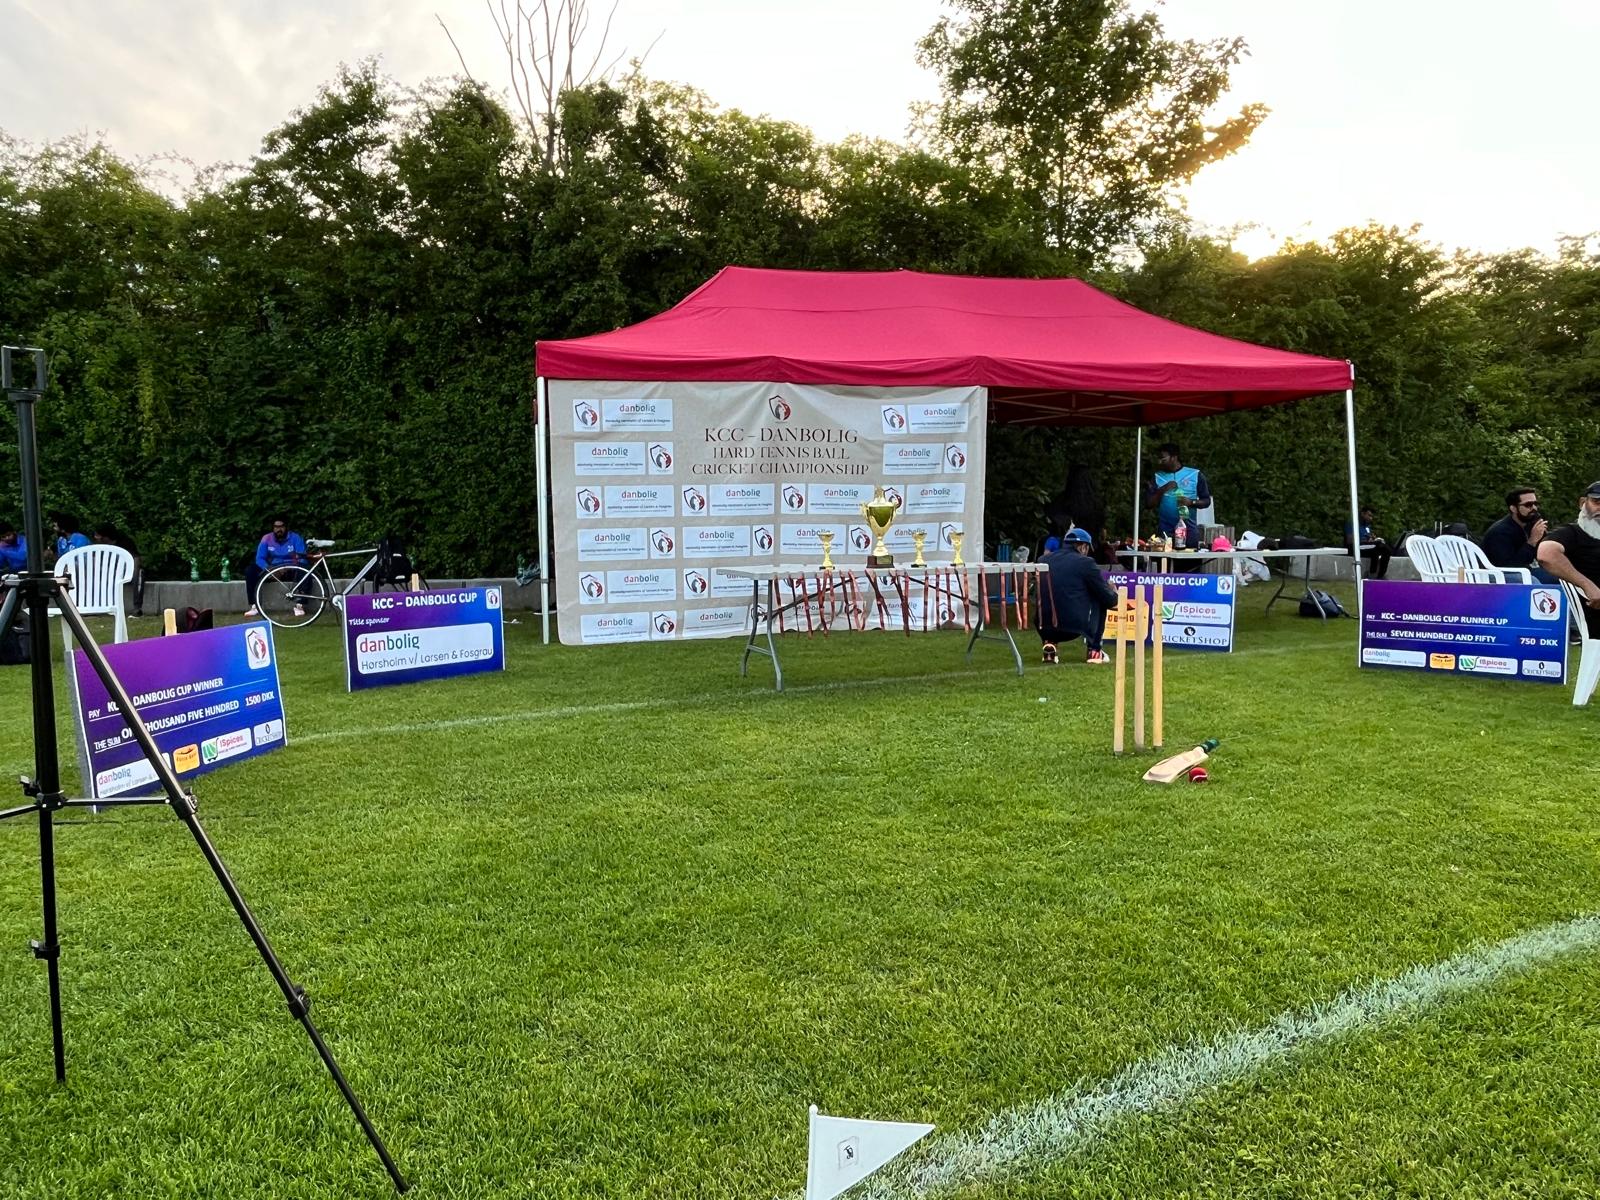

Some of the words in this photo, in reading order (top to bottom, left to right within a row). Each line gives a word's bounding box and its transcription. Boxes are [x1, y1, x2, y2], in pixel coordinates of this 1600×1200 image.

[619, 404, 656, 415] danbolig
[923, 407, 957, 417] danbolig
[705, 428, 744, 442] KCC
[761, 427, 858, 443] DANBOLIG
[591, 447, 628, 457] danbolig
[713, 447, 755, 458] HARD
[759, 446, 810, 458] TENNIS
[813, 447, 850, 459] BALL
[898, 448, 931, 457] danbolig
[692, 463, 758, 475] CRICKET
[759, 462, 869, 475] CHAMPIONSHIP
[621, 490, 658, 500] danbolig
[725, 488, 761, 498] danbolig
[823, 488, 859, 498] danbolig
[920, 488, 951, 497] danbolig
[594, 533, 631, 543] danbolig
[698, 530, 735, 540] danbolig
[623, 574, 660, 584] danbolig
[1137, 576, 1187, 586] DANBOLIG
[1188, 577, 1209, 587] CUP
[372, 598, 395, 610] KCC
[405, 594, 457, 607] DANBOLIG
[458, 592, 478, 604] CUP
[699, 611, 733, 621] danbolig
[1381, 612, 1396, 620] KCC
[1402, 613, 1442, 622] DANBOLIG
[1443, 615, 1460, 623] CUP
[1461, 616, 1495, 625] RUNNER
[365, 617, 390, 627] sponsor
[597, 618, 633, 628] danbolig
[359, 634, 420, 653] danbolig
[1390, 630, 1415, 639] SEVEN
[1415, 631, 1454, 641] HUNDRED
[1454, 634, 1473, 642] AND
[1474, 635, 1497, 643] FIFTY
[1520, 637, 1536, 646] 750
[1540, 638, 1559, 647] DKK
[420, 652, 450, 663] Larsen
[451, 651, 459, 659] &
[88, 709, 101, 719] PAY
[132, 688, 176, 707] DANBOLIG
[177, 685, 192, 697] CUP
[192, 678, 224, 694] WINNER
[94, 740, 107, 751] THE
[107, 736, 121, 748] SUM
[187, 709, 204, 722] FIVE
[205, 700, 240, 717] HUNDRED
[245, 694, 261, 707] 1500
[261, 691, 275, 703] DKK
[98, 766, 132, 785] danbolig
